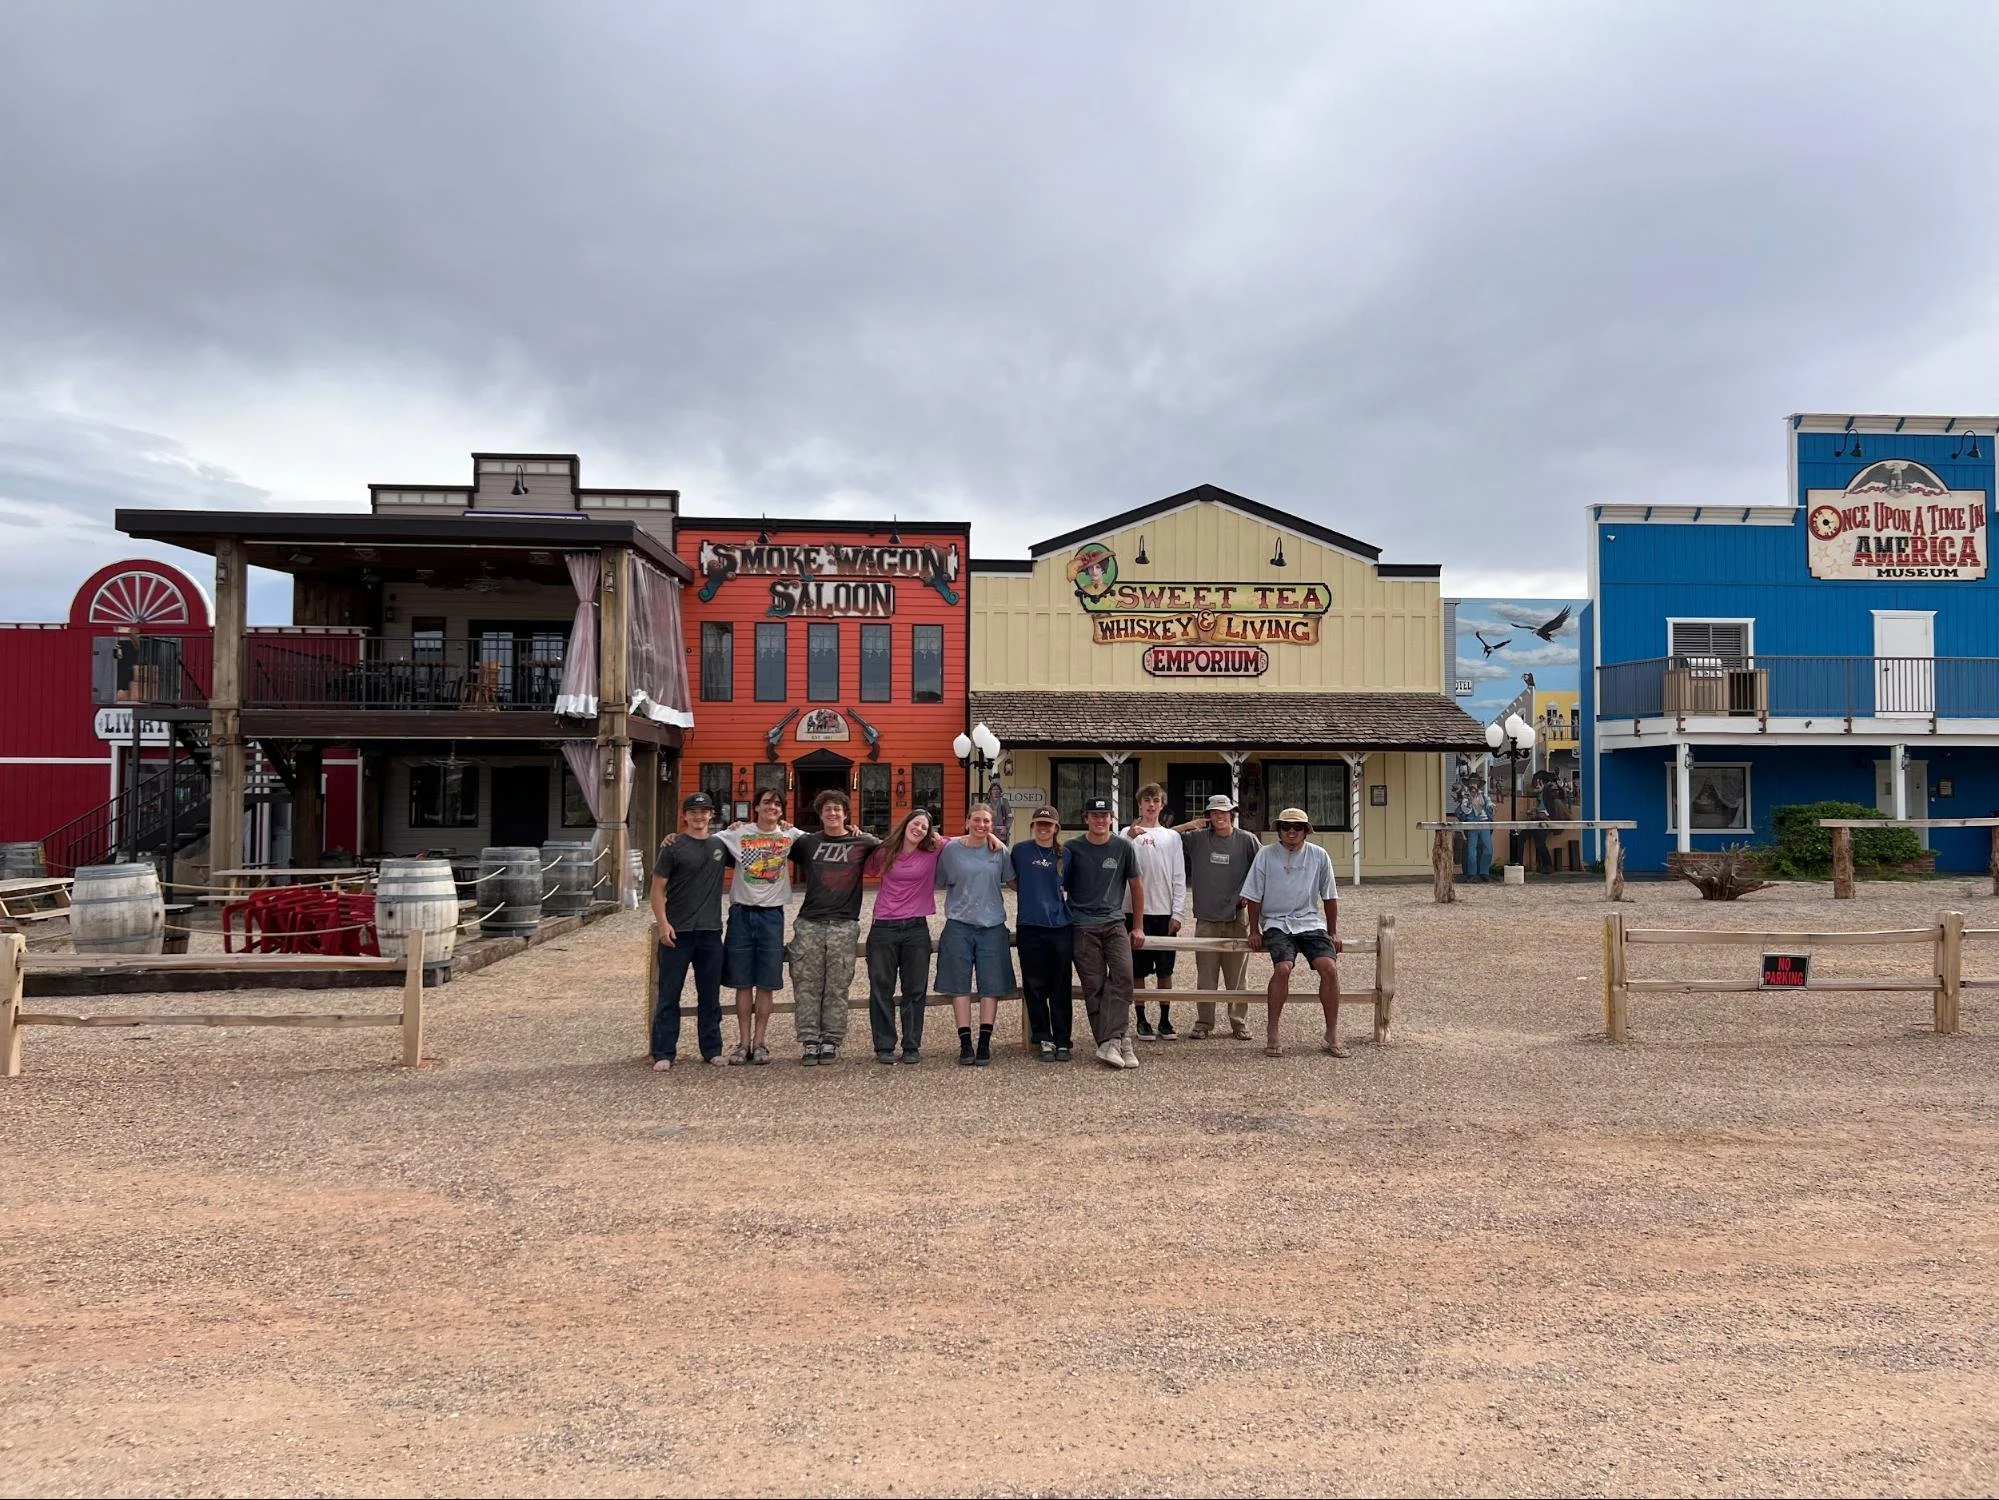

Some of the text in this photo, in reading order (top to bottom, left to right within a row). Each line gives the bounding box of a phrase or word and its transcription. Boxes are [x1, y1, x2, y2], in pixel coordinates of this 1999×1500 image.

[1808, 501, 1986, 541] ONCE UPON A TIME IN
[707, 543, 950, 578] SMOKE WAGON
[1851, 535, 1981, 568] AMERICA
[1876, 568, 1960, 578] MUSEUM
[769, 580, 893, 617] SALOON
[1116, 586, 1324, 610] SWEET TEA
[1099, 611, 1310, 641] WHISKEY & LIVING
[1152, 649, 1260, 672] EMPORIUM
[812, 842, 854, 863] FOX
[1777, 957, 1791, 971] NO
[1764, 971, 1804, 985] PARKING
